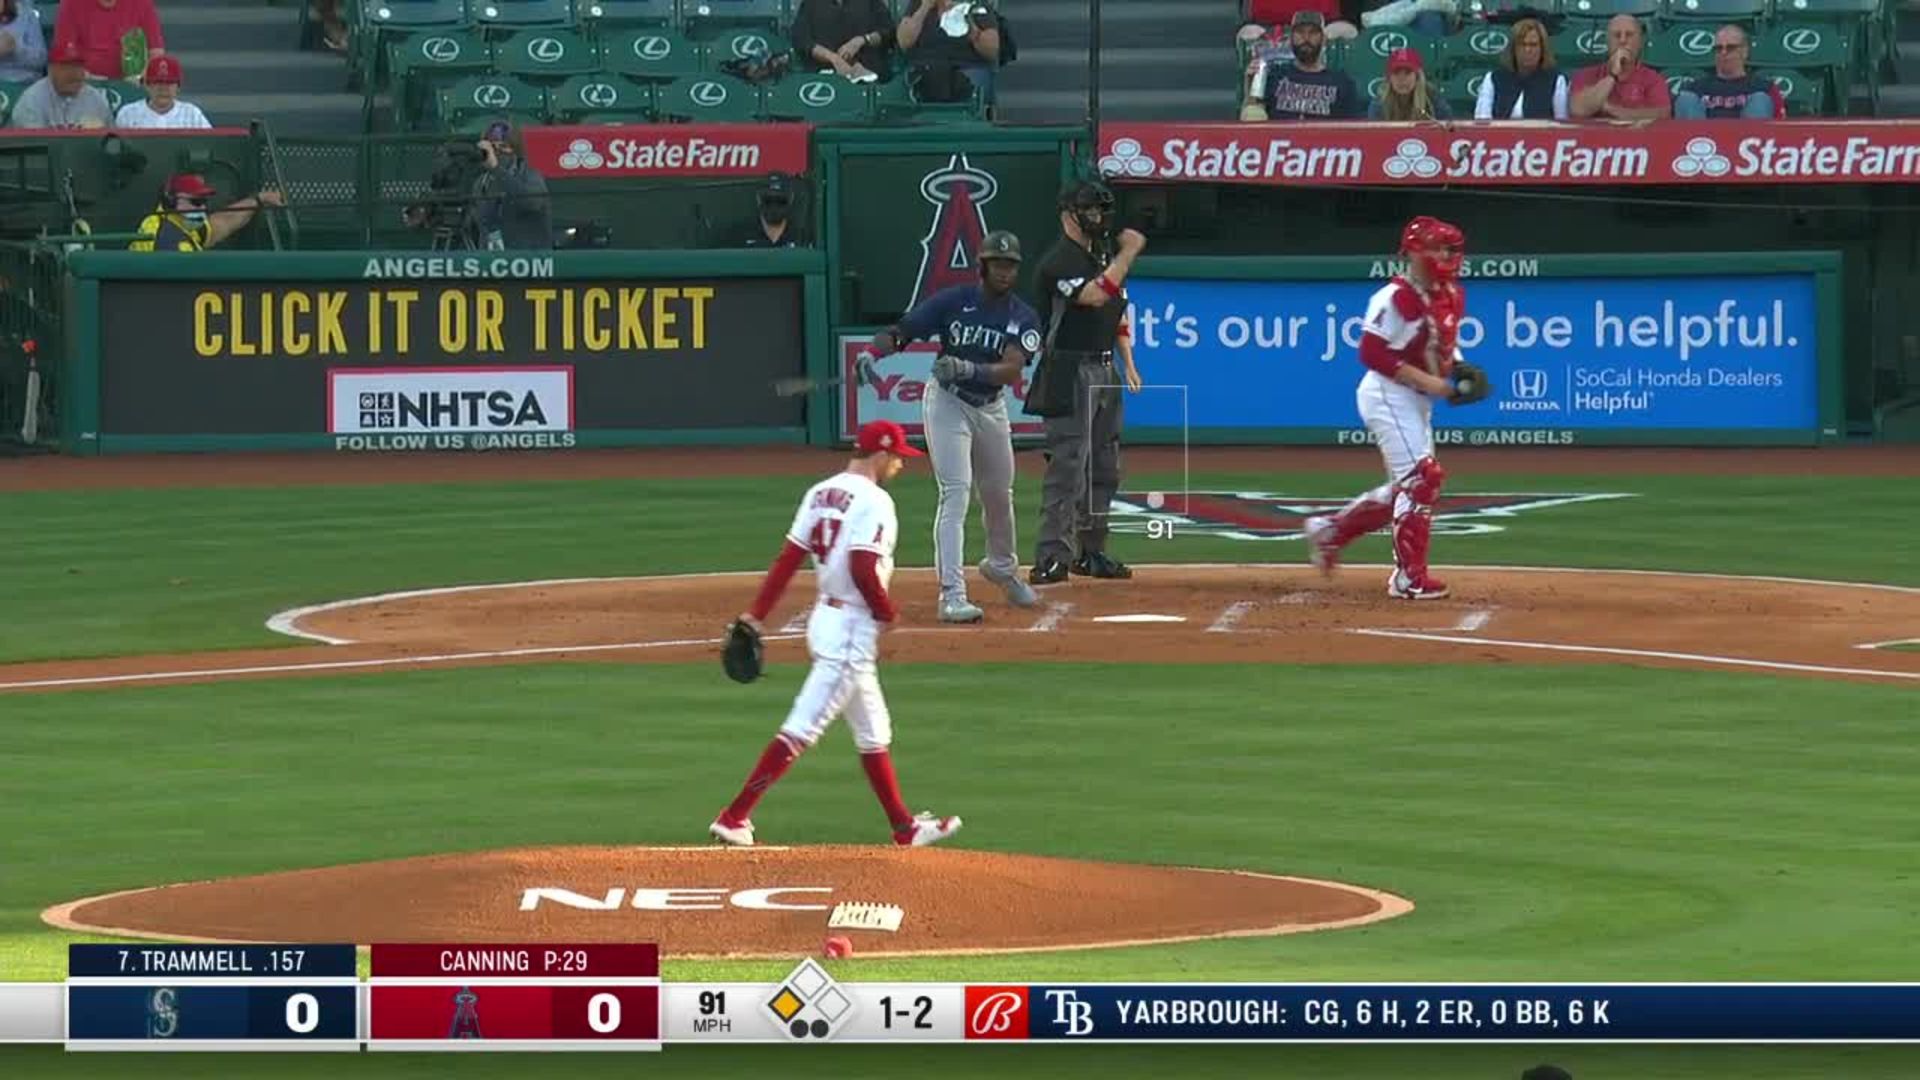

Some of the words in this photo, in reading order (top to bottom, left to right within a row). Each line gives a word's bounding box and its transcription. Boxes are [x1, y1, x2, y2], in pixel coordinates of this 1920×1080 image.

[363, 257, 554, 278] ANGELS.COM
[1370, 259, 1539, 277] ANS.COM
[194, 290, 348, 356] CLICK
[369, 290, 419, 354] IT
[439, 289, 505, 353] OR
[525, 287, 715, 351] TICKET
[1217, 315, 1309, 349] our
[1320, 303, 1366, 361] jo
[1506, 300, 1573, 348] be
[1595, 299, 1798, 361] helpful.
[1575, 367, 1632, 387] SoCal
[1638, 368, 1702, 387] Honda
[1708, 367, 1783, 387] Dealers
[398, 389, 548, 428] NHTSA
[1499, 401, 1561, 411] HONDA
[1575, 391, 1649, 414] Helpful
[335, 434, 427, 450] FOLLOW
[434, 433, 464, 449] US
[471, 432, 576, 449] @ANGELS
[1435, 430, 1464, 444] US
[1469, 429, 1574, 445] @ANGELS
[519, 887, 834, 911] NEC
